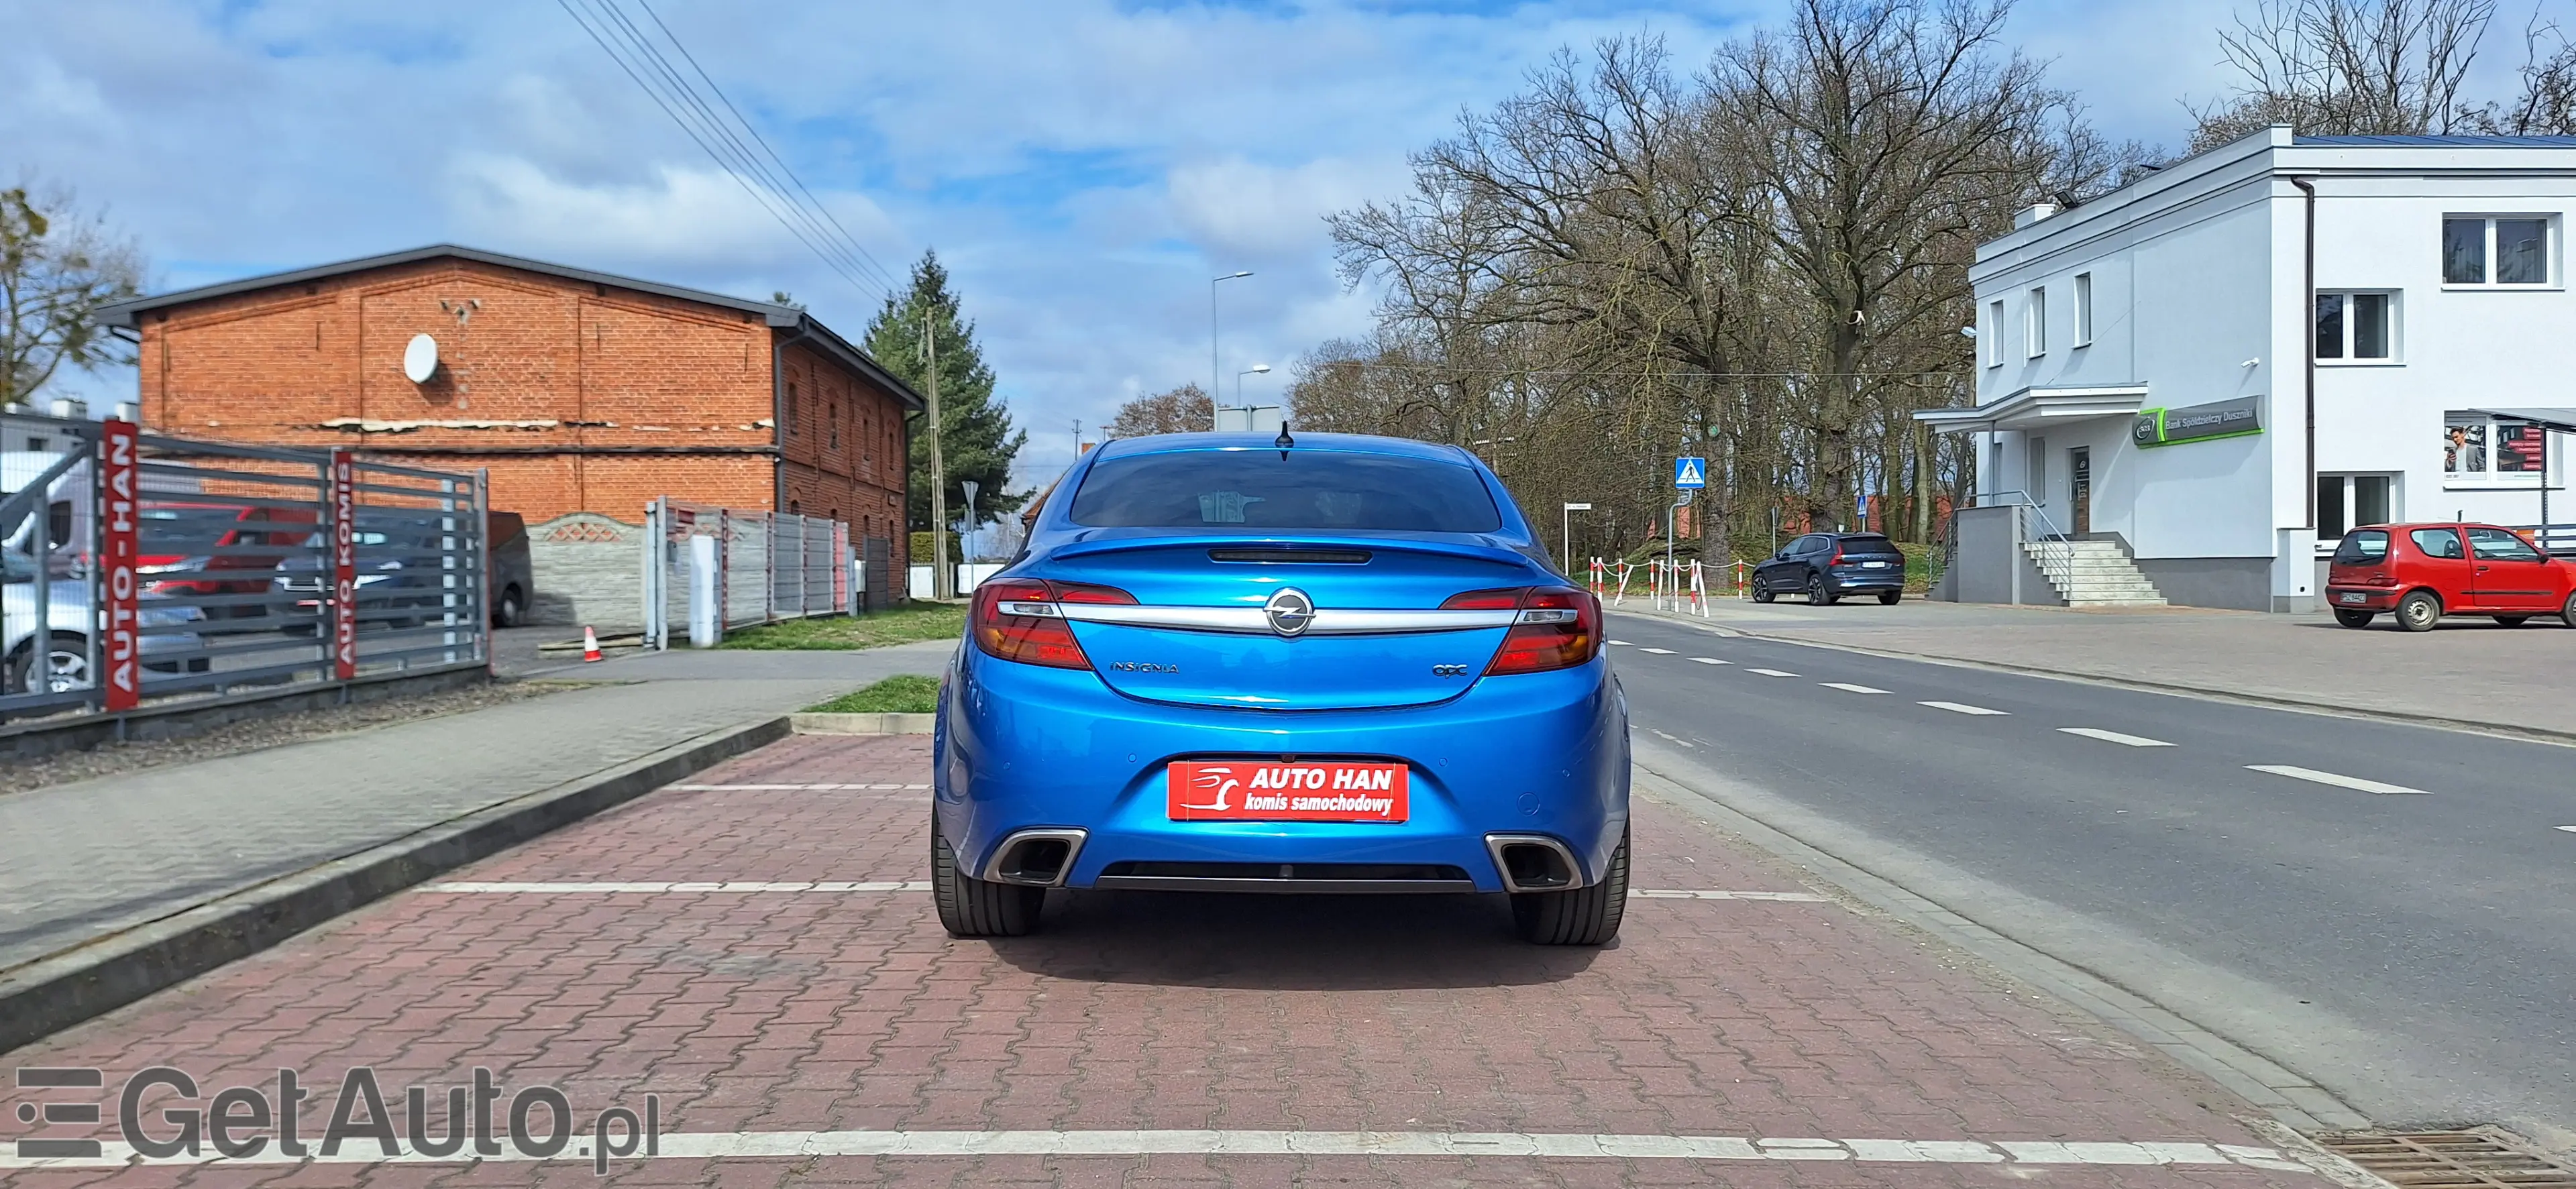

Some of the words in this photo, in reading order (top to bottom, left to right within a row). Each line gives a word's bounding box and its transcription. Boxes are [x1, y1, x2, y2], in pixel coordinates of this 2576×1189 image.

[2165, 420, 2182, 430] Bank
[2182, 414, 2222, 429] Spółdzielczy
[2223, 408, 2253, 422] Duszniki
[337, 461, 352, 567] KOMIS
[339, 578, 354, 665] AUTO
[1110, 661, 1180, 674] INSIGNIA
[1248, 768, 1327, 789] AUTO
[1332, 769, 1394, 791] HAN
[1244, 792, 1289, 811] komis
[1291, 793, 1394, 817] samochodowy
